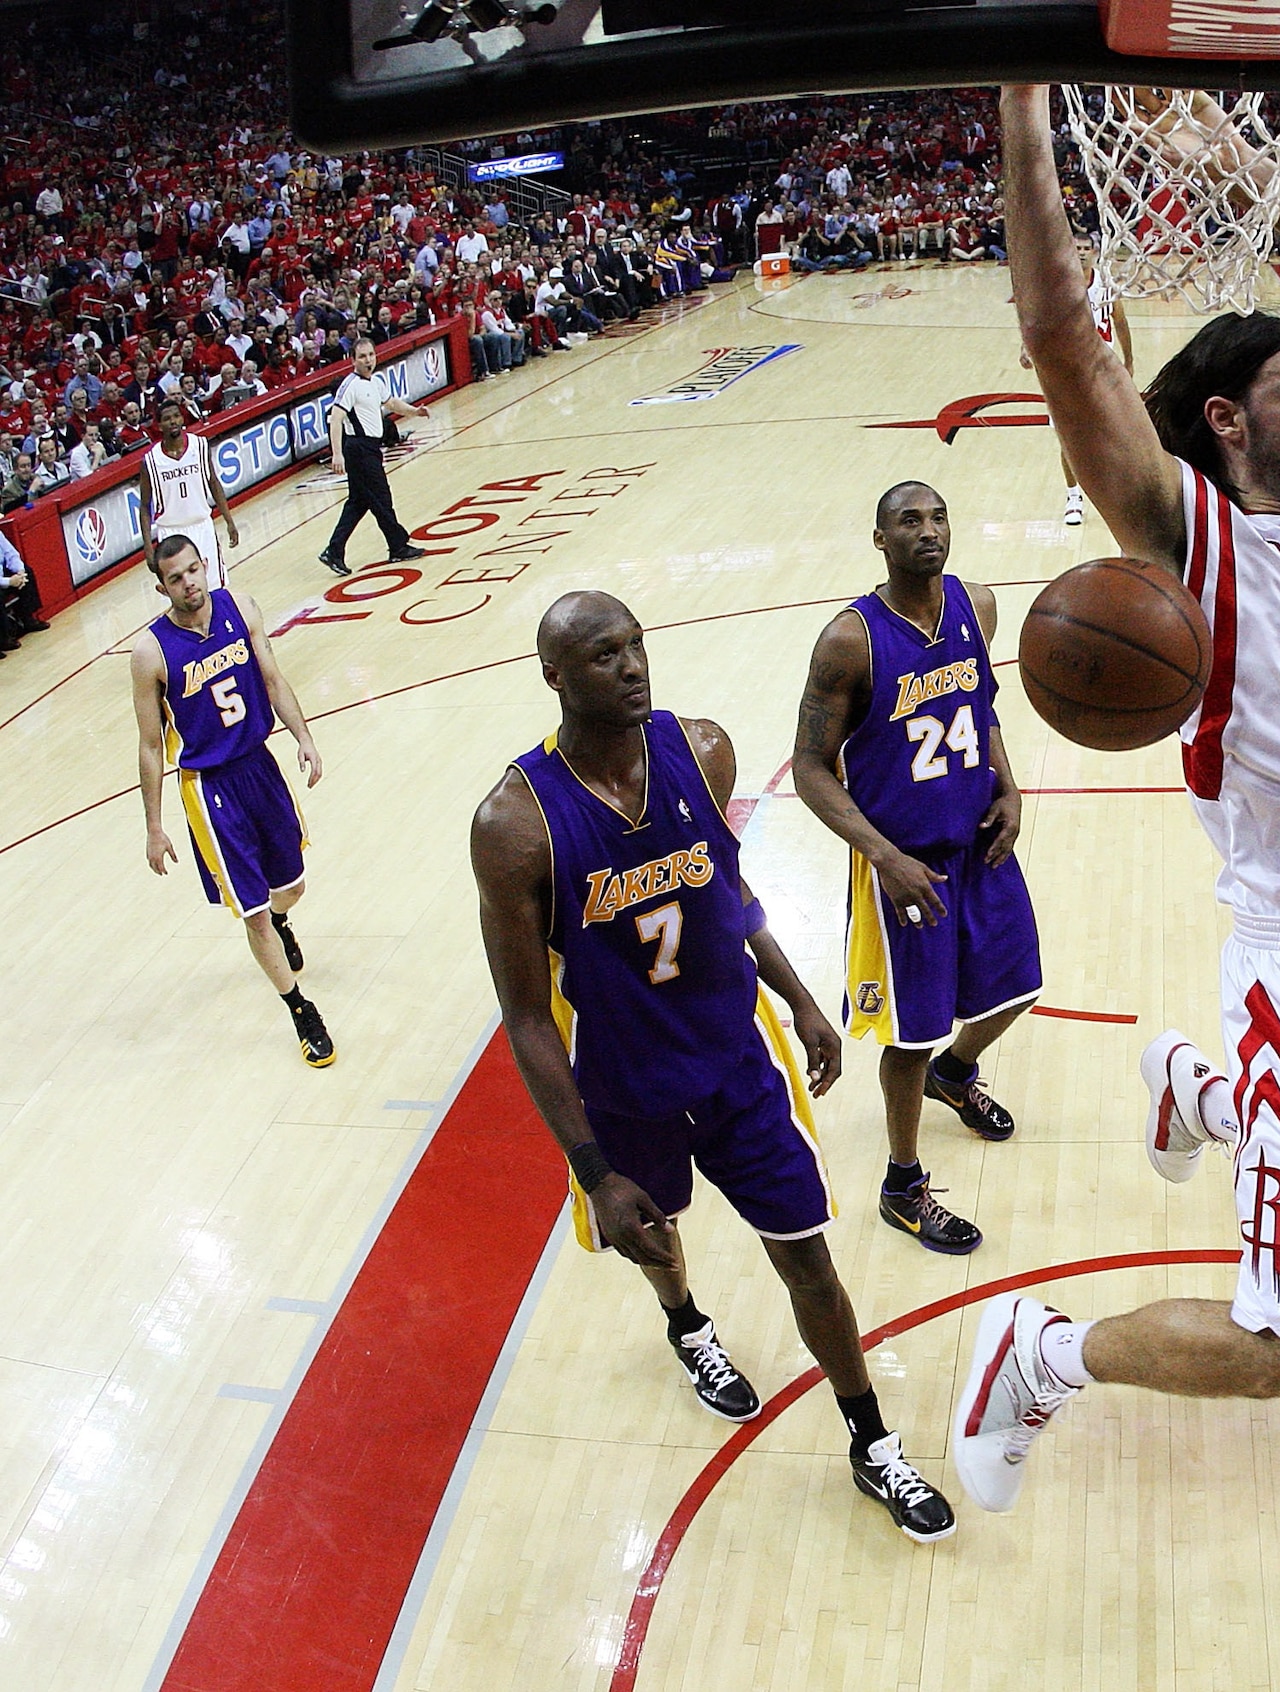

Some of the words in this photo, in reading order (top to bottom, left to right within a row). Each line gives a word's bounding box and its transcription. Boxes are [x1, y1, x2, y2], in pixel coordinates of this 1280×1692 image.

[771, 260, 781, 270] G
[161, 463, 199, 482] ROCKETS
[179, 481, 188, 499] 0
[399, 461, 657, 625] CENTER
[182, 638, 250, 699] LAKERS
[889, 658, 979, 722] LAKERS
[210, 675, 247, 728] 5
[905, 704, 980, 783] 24
[582, 841, 714, 929] LAKERS
[634, 900, 684, 985] 7
